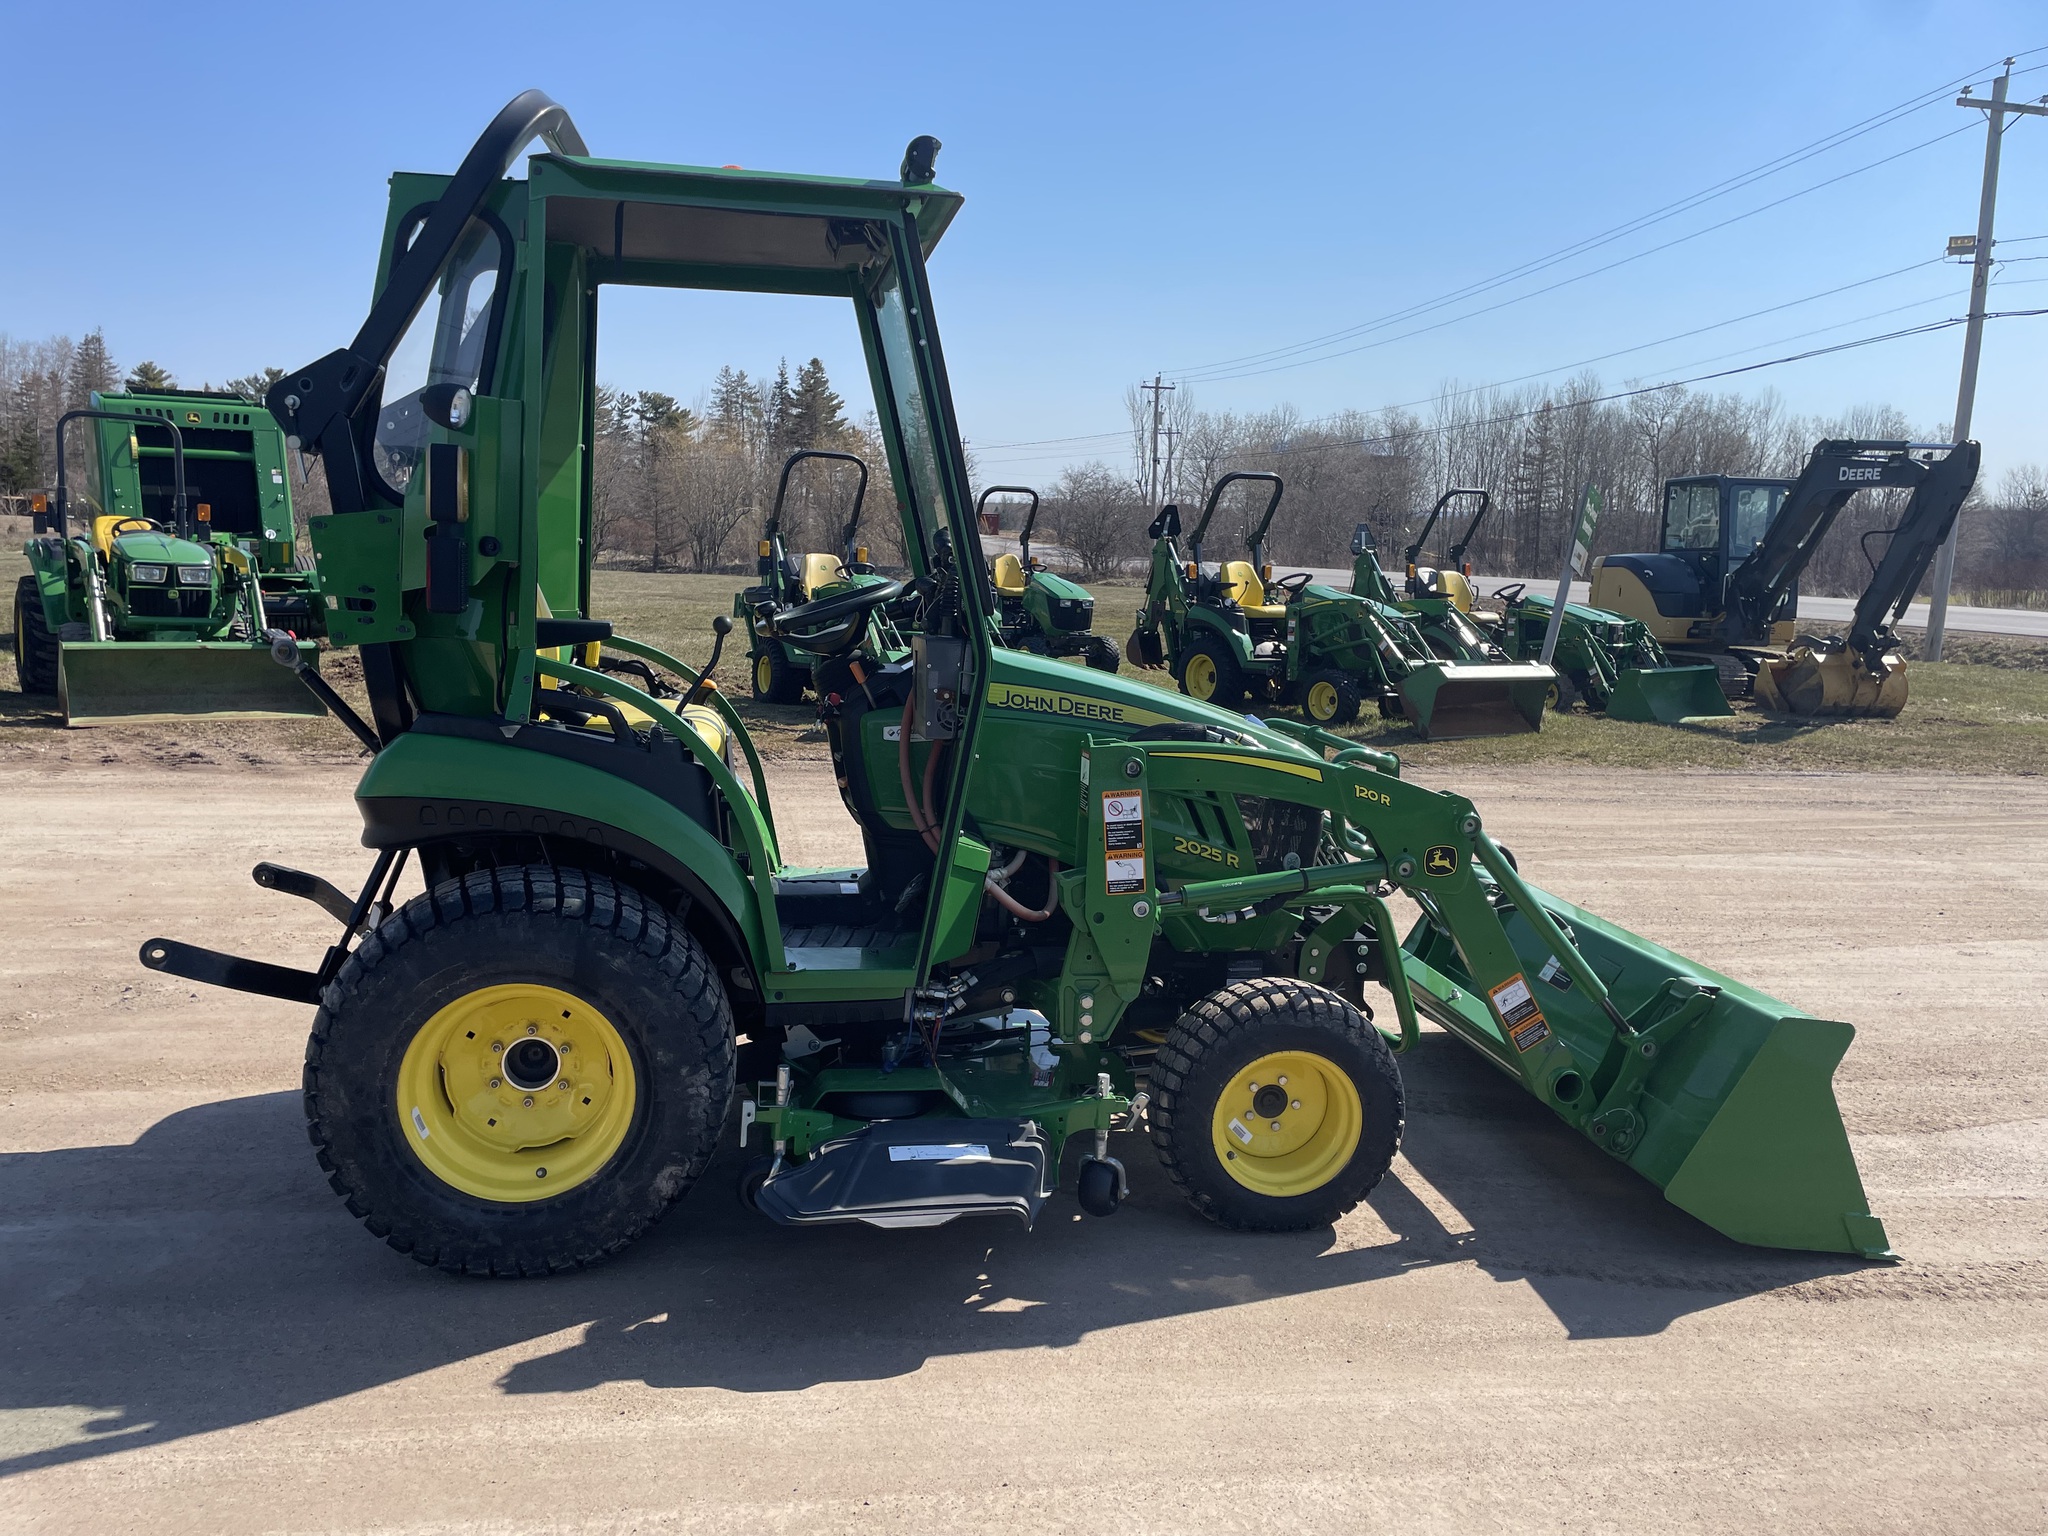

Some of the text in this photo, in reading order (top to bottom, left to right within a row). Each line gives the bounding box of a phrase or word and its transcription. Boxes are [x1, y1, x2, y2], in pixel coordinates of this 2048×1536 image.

[1838, 466, 1882, 481] DEERE
[999, 690, 1124, 722] JOHN DEERE
[1109, 790, 1140, 798] WARNING
[1354, 784, 1391, 807] 120 R
[1174, 836, 1239, 869] 2025 R
